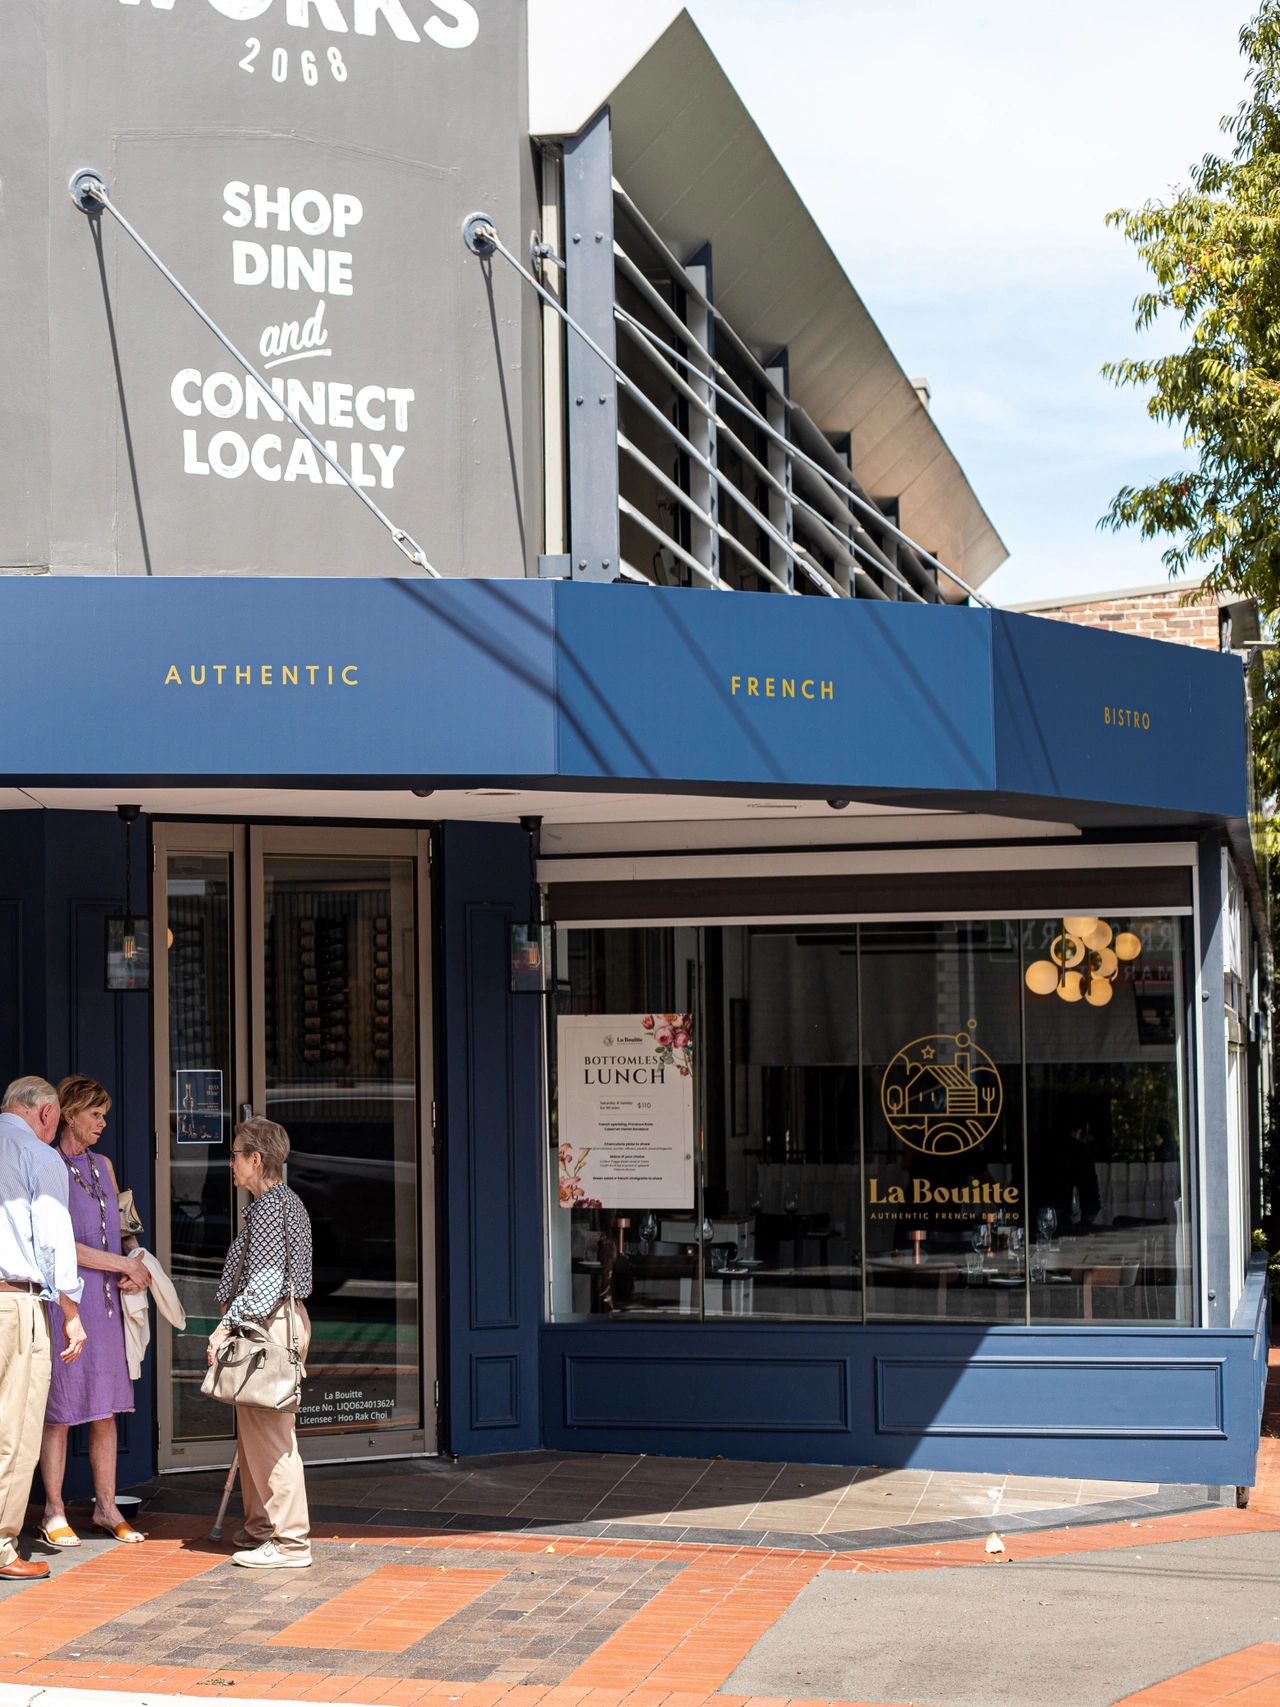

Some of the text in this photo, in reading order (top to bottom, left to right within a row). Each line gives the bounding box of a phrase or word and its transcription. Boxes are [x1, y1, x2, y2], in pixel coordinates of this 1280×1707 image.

[238, 37, 348, 86] 2068
[222, 180, 363, 238] SHOP
[232, 240, 353, 296] DINE
[259, 299, 328, 358] and
[170, 368, 415, 432] CONNECT
[183, 429, 405, 489] LOCALLY
[164, 664, 359, 686] AUTHENTIC
[731, 676, 834, 700] FRENCH
[1104, 706, 1151, 730] BISTRO
[584, 1055, 666, 1065] BOTTOMLESS
[584, 1068, 666, 1085] LUNCH
[637, 1102, 652, 1110] $110
[869, 1178, 1019, 1204] La Bouitte
[871, 1212, 929, 1220] AUTHENTIC
[935, 1212, 976, 1220] FRENCH
[324, 1390, 363, 1400] La Bouitte
[299, 1405, 320, 1413] cence
[322, 1403, 335, 1412] No.
[300, 1414, 332, 1425] Licensee
[338, 1414, 353, 1422] Hoo
[355, 1412, 369, 1421] Rak
